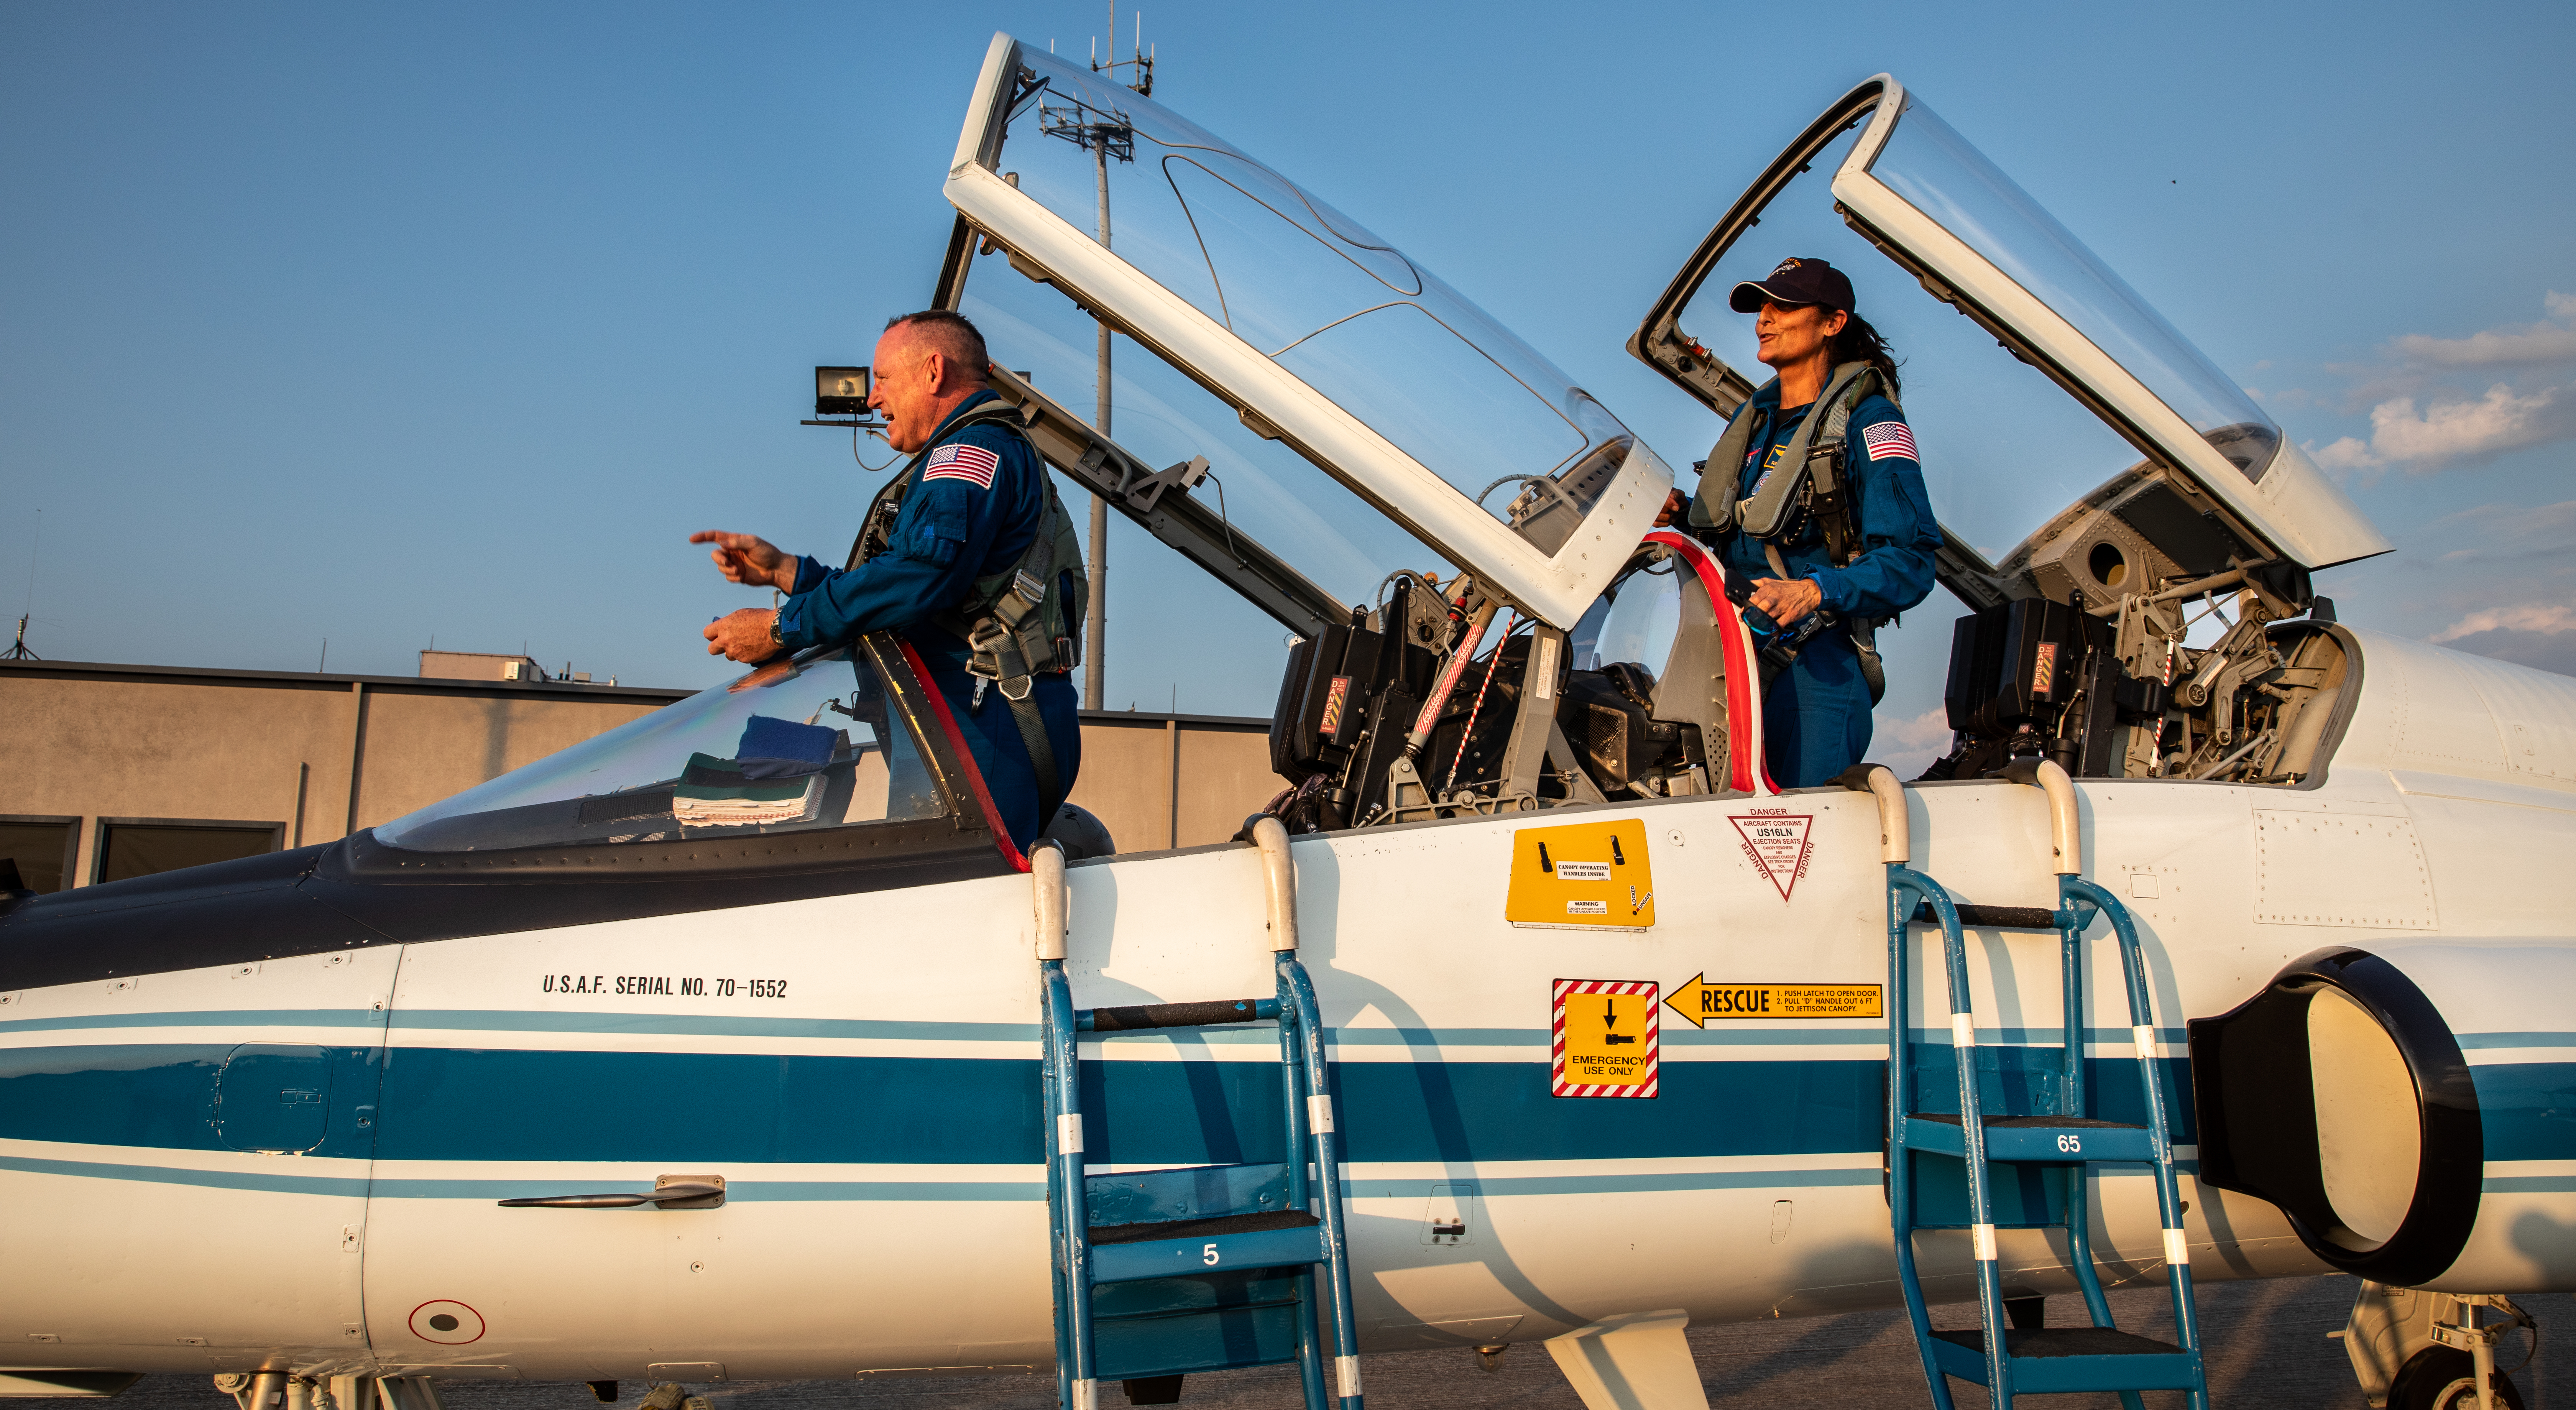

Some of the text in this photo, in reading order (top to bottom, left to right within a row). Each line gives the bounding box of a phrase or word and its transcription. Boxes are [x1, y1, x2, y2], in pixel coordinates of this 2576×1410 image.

[2034, 646, 2045, 685] DANGER
[1322, 680, 1338, 725] DANGER
[1757, 828, 1793, 836] US16LN
[1741, 842, 1769, 879] DANGER
[1797, 841, 1814, 879] DANGER
[1638, 892, 1651, 909] UNSAFE
[543, 975, 787, 998] U.S.A.F. SERIAL NO. 70-1552
[1702, 990, 1769, 1012] RESCUE
[1572, 1055, 1645, 1065] EMERGENCY
[1584, 1066, 1633, 1075] USE ONLY
[2057, 1135, 2080, 1153] 65
[1203, 1243, 1219, 1265] 5
